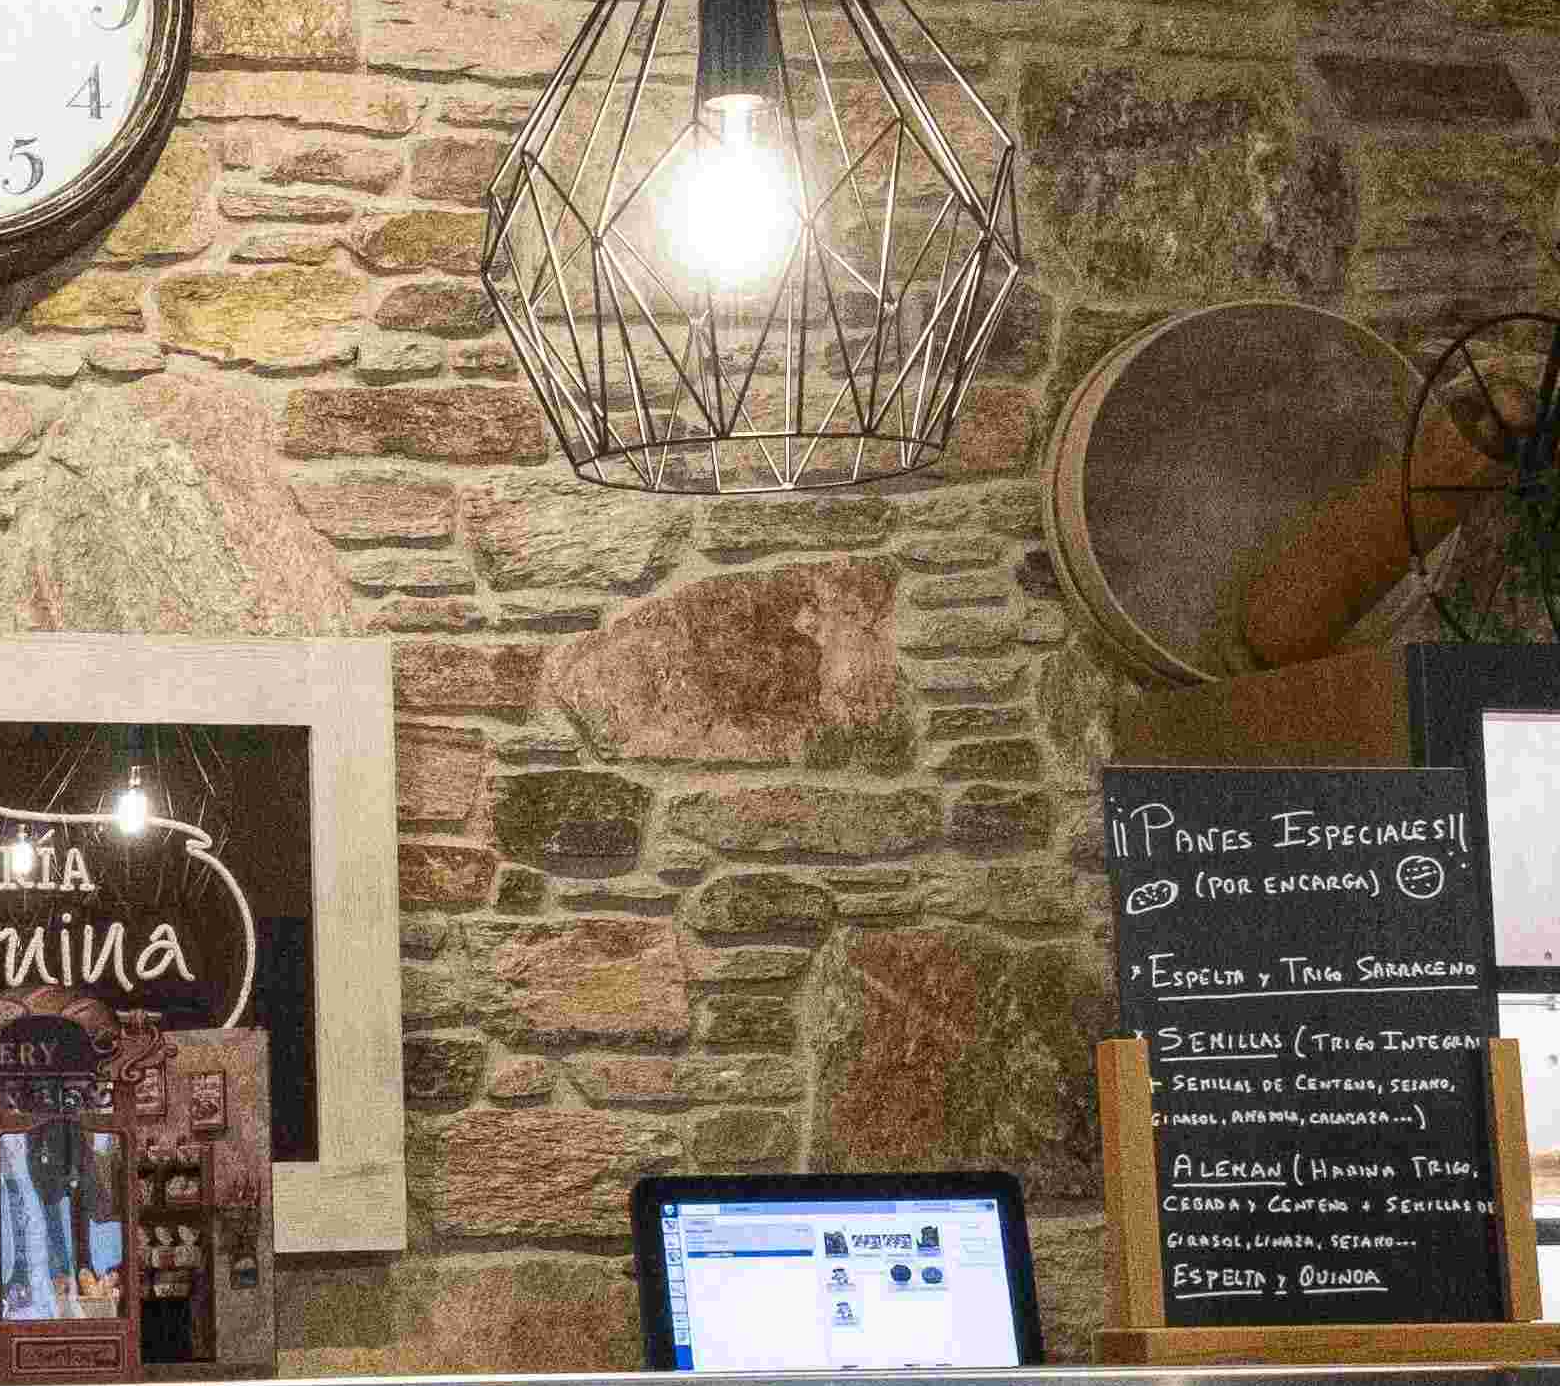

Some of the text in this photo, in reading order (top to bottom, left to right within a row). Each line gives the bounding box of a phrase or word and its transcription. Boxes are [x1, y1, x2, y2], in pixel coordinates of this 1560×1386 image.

[65, 62, 113, 120] 4
[1, 136, 44, 195] 5
[1195, 870, 1253, 900] (POR
[1148, 953, 1247, 989] ESPELTA
[1279, 956, 1342, 984] TRIGO
[1356, 955, 1476, 981] SARRACENO
[1158, 1026, 1282, 1053] SEMILLAS
[1173, 1153, 1282, 1179] ALEMAN
[1173, 1263, 1267, 1290] ESPELTA
[1299, 1264, 1380, 1287] QUINOA
